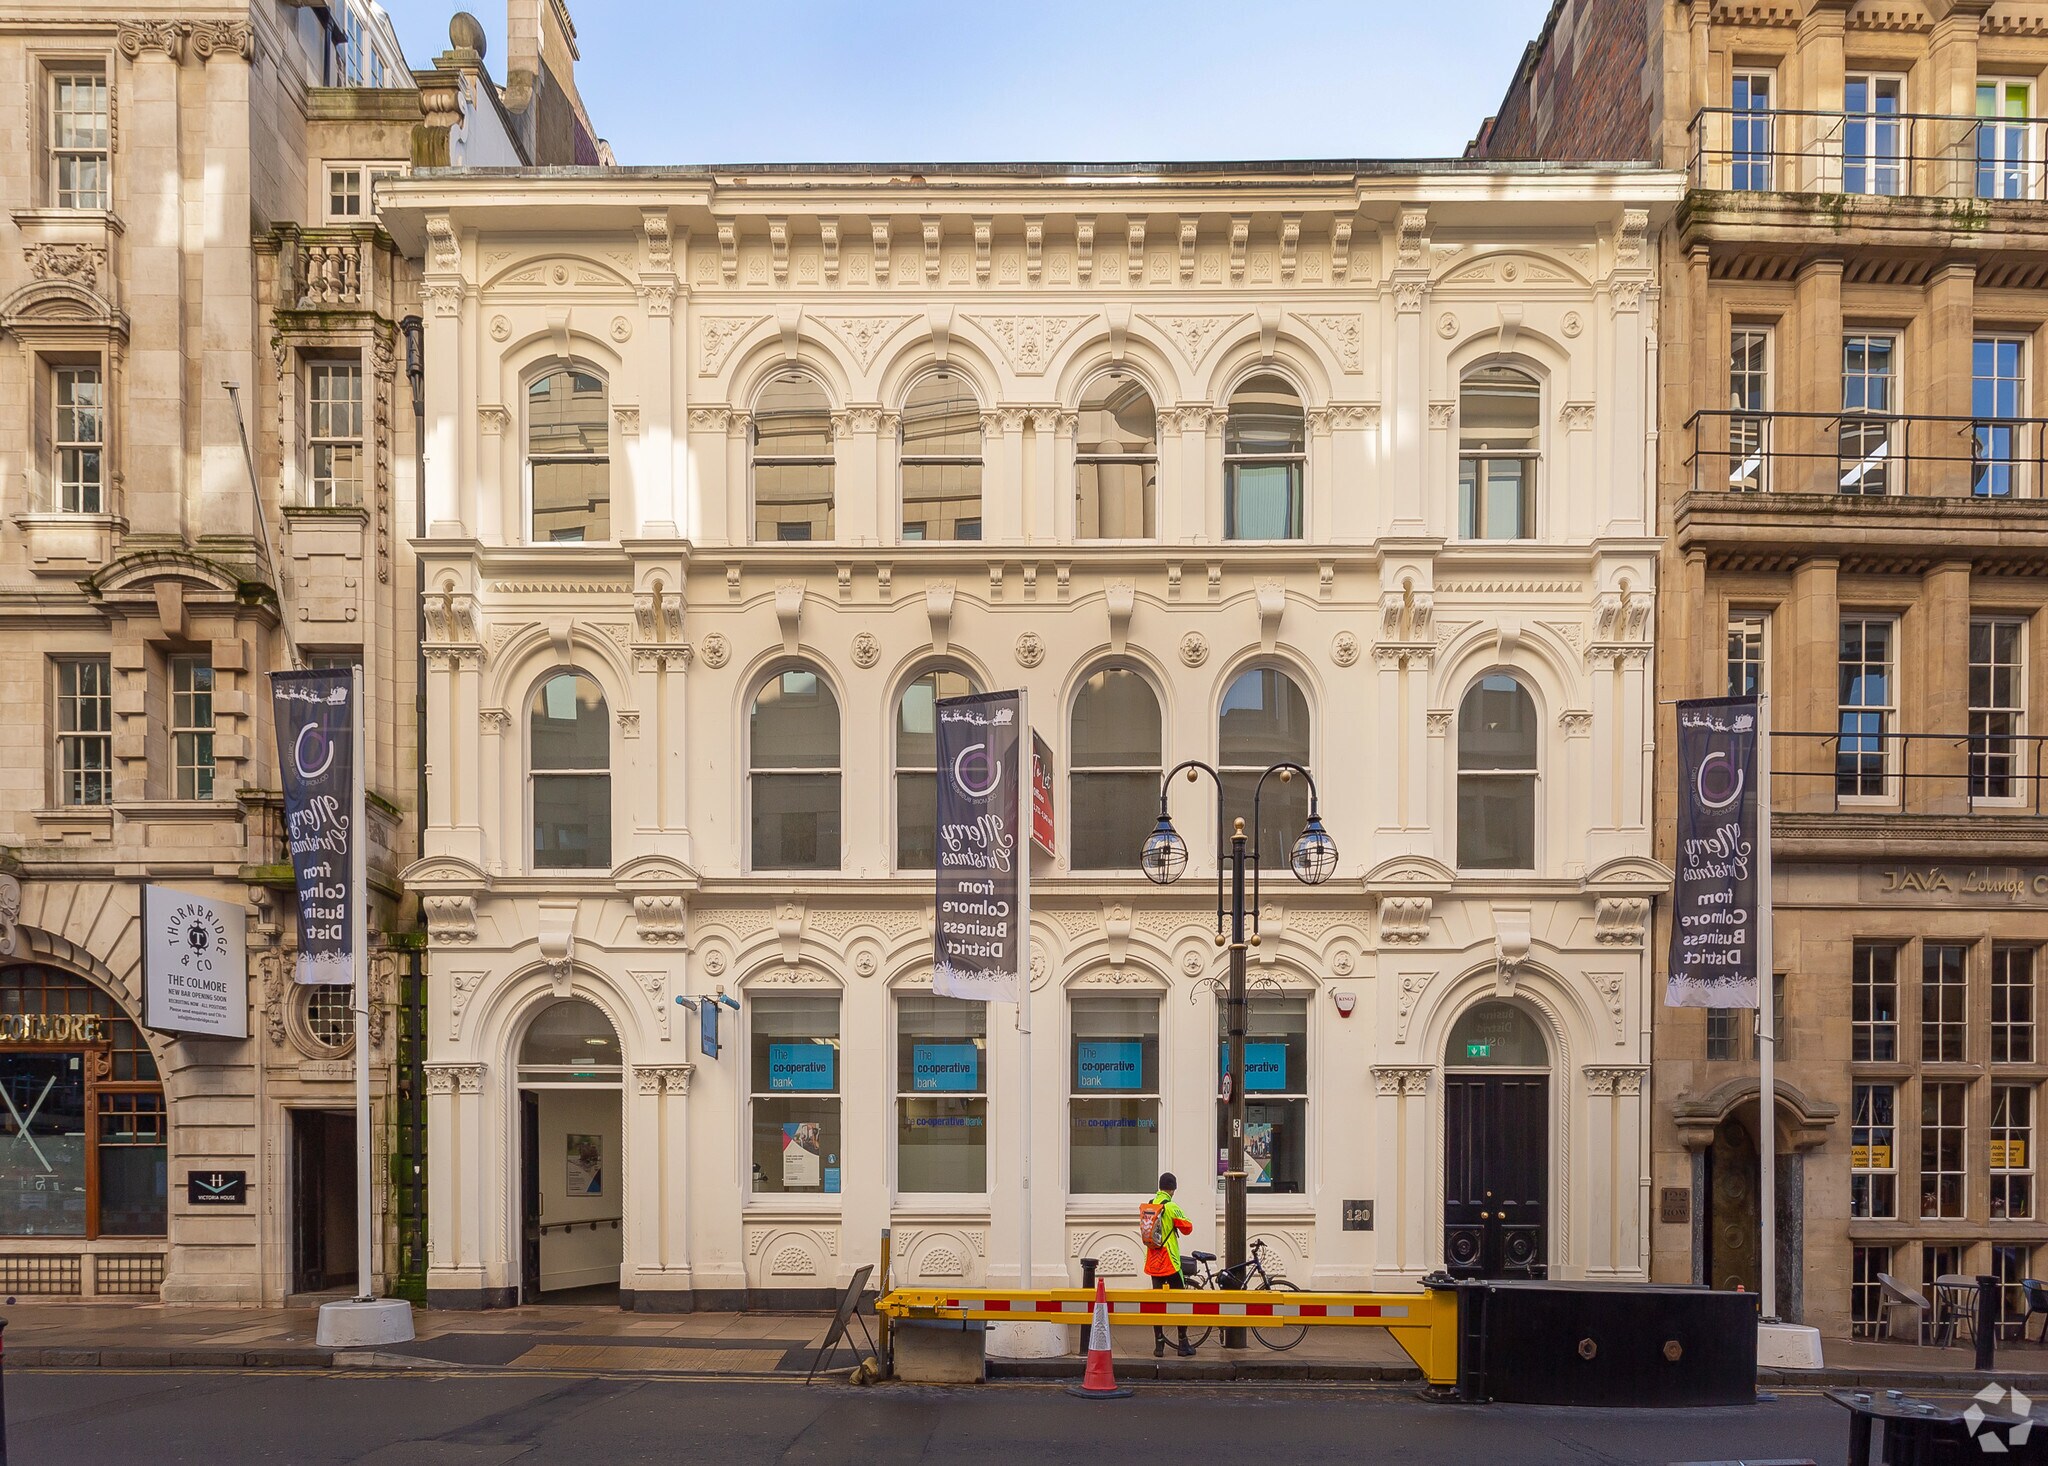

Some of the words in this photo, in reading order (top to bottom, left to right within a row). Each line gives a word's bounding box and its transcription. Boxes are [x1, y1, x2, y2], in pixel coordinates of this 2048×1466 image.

[1042, 764, 1052, 789] Let
[1883, 869, 1952, 890] JAVA
[1961, 870, 2025, 901] Lounge
[167, 904, 227, 956] THORNBRIDGE
[181, 954, 190, 966] &
[196, 959, 213, 971] CO
[168, 974, 184, 986] THE
[186, 977, 227, 993] COLMORE
[168, 988, 180, 996] NEW
[180, 990, 191, 998] BAR
[191, 992, 213, 1000] OPENING
[773, 1048, 788, 1060] The
[917, 1049, 932, 1061] The
[1082, 1047, 1096, 1059] The
[773, 1062, 826, 1074] co-operative
[917, 1062, 970, 1075] co-operative
[1082, 1061, 1135, 1073] co-operative
[772, 1076, 794, 1088] bank
[917, 1077, 937, 1088] bank
[1081, 1075, 1102, 1086] bank
[916, 1116, 964, 1128] co-operative
[1088, 1117, 1137, 1128] co-operative
[1138, 1117, 1155, 1128] bank
[1664, 1191, 1687, 1202] 122
[1346, 1209, 1371, 1221] 120
[1664, 1209, 1686, 1217] ROW
